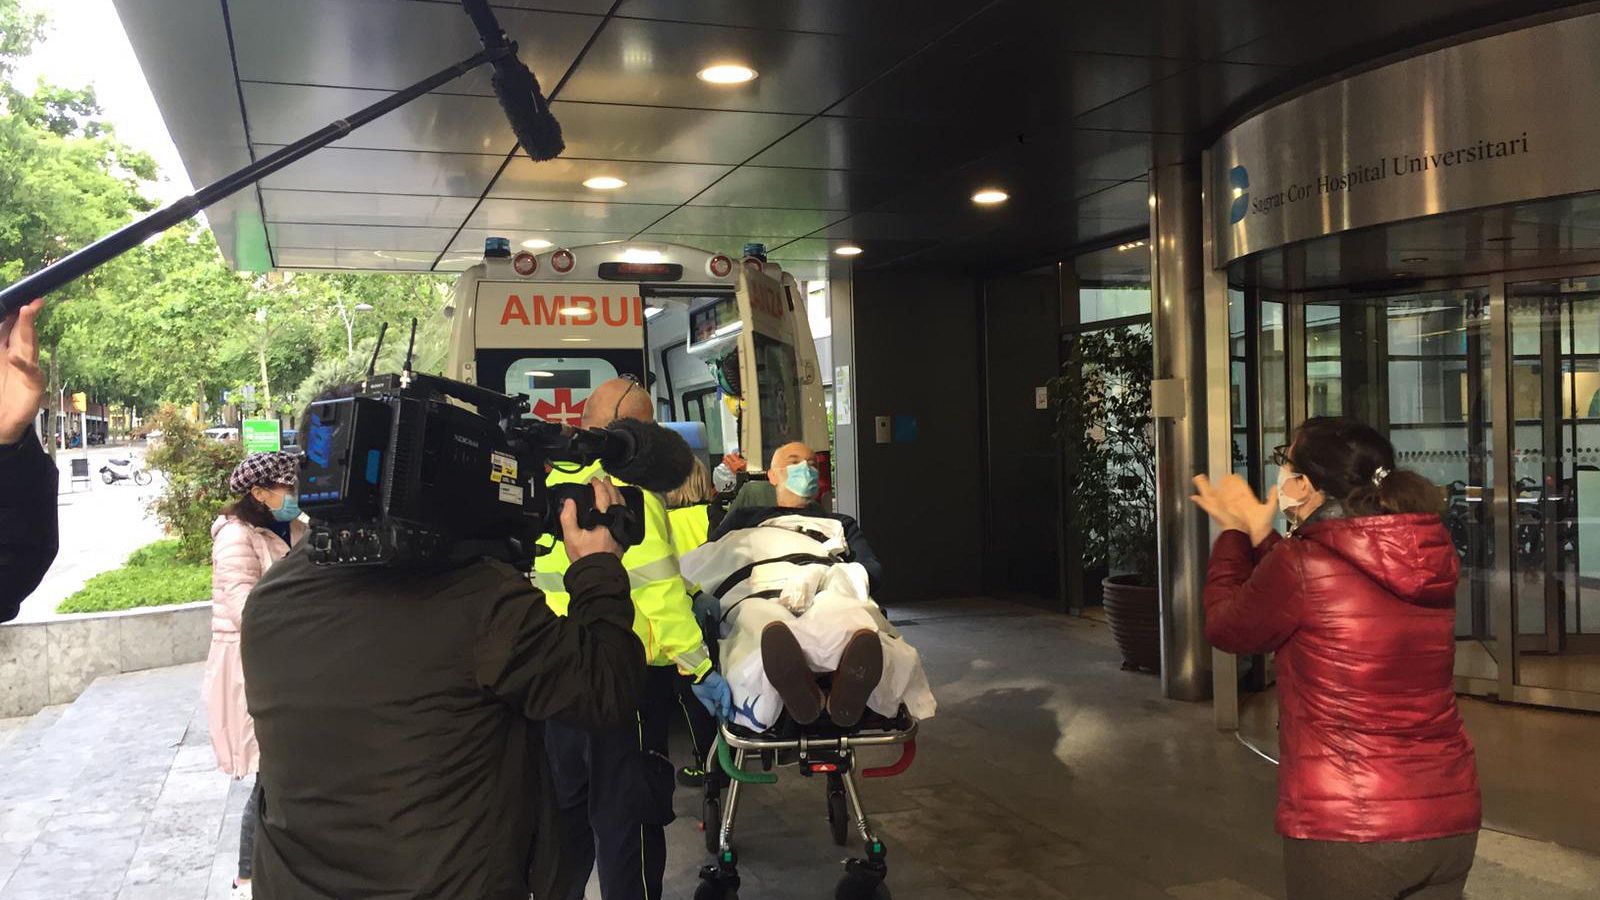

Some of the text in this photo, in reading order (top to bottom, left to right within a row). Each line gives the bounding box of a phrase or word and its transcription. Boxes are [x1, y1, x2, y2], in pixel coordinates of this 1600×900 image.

[1251, 132, 1529, 214] Sagrat Cor Hospital Universitari
